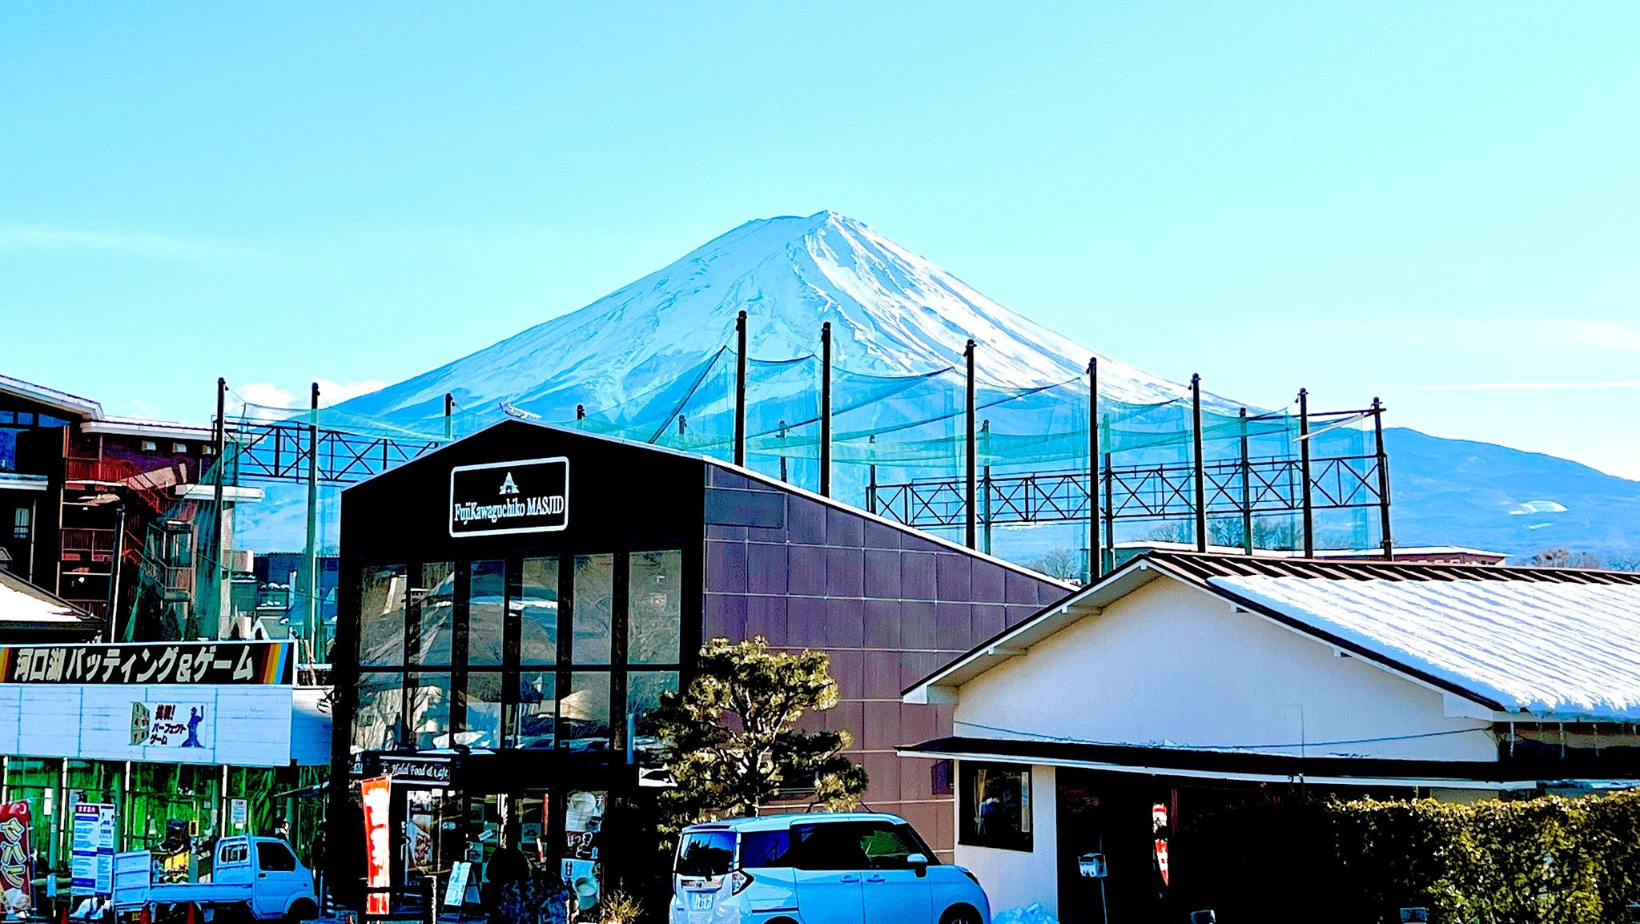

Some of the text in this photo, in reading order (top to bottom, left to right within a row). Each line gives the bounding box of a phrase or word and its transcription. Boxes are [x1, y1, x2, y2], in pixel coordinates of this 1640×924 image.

[454, 495, 564, 525] FujiKawaguchiko MASJID
[14, 645, 254, 683] 河口湖バッティング&ゲーム
[391, 763, 410, 777] Halal
[410, 763, 427, 776] Food
